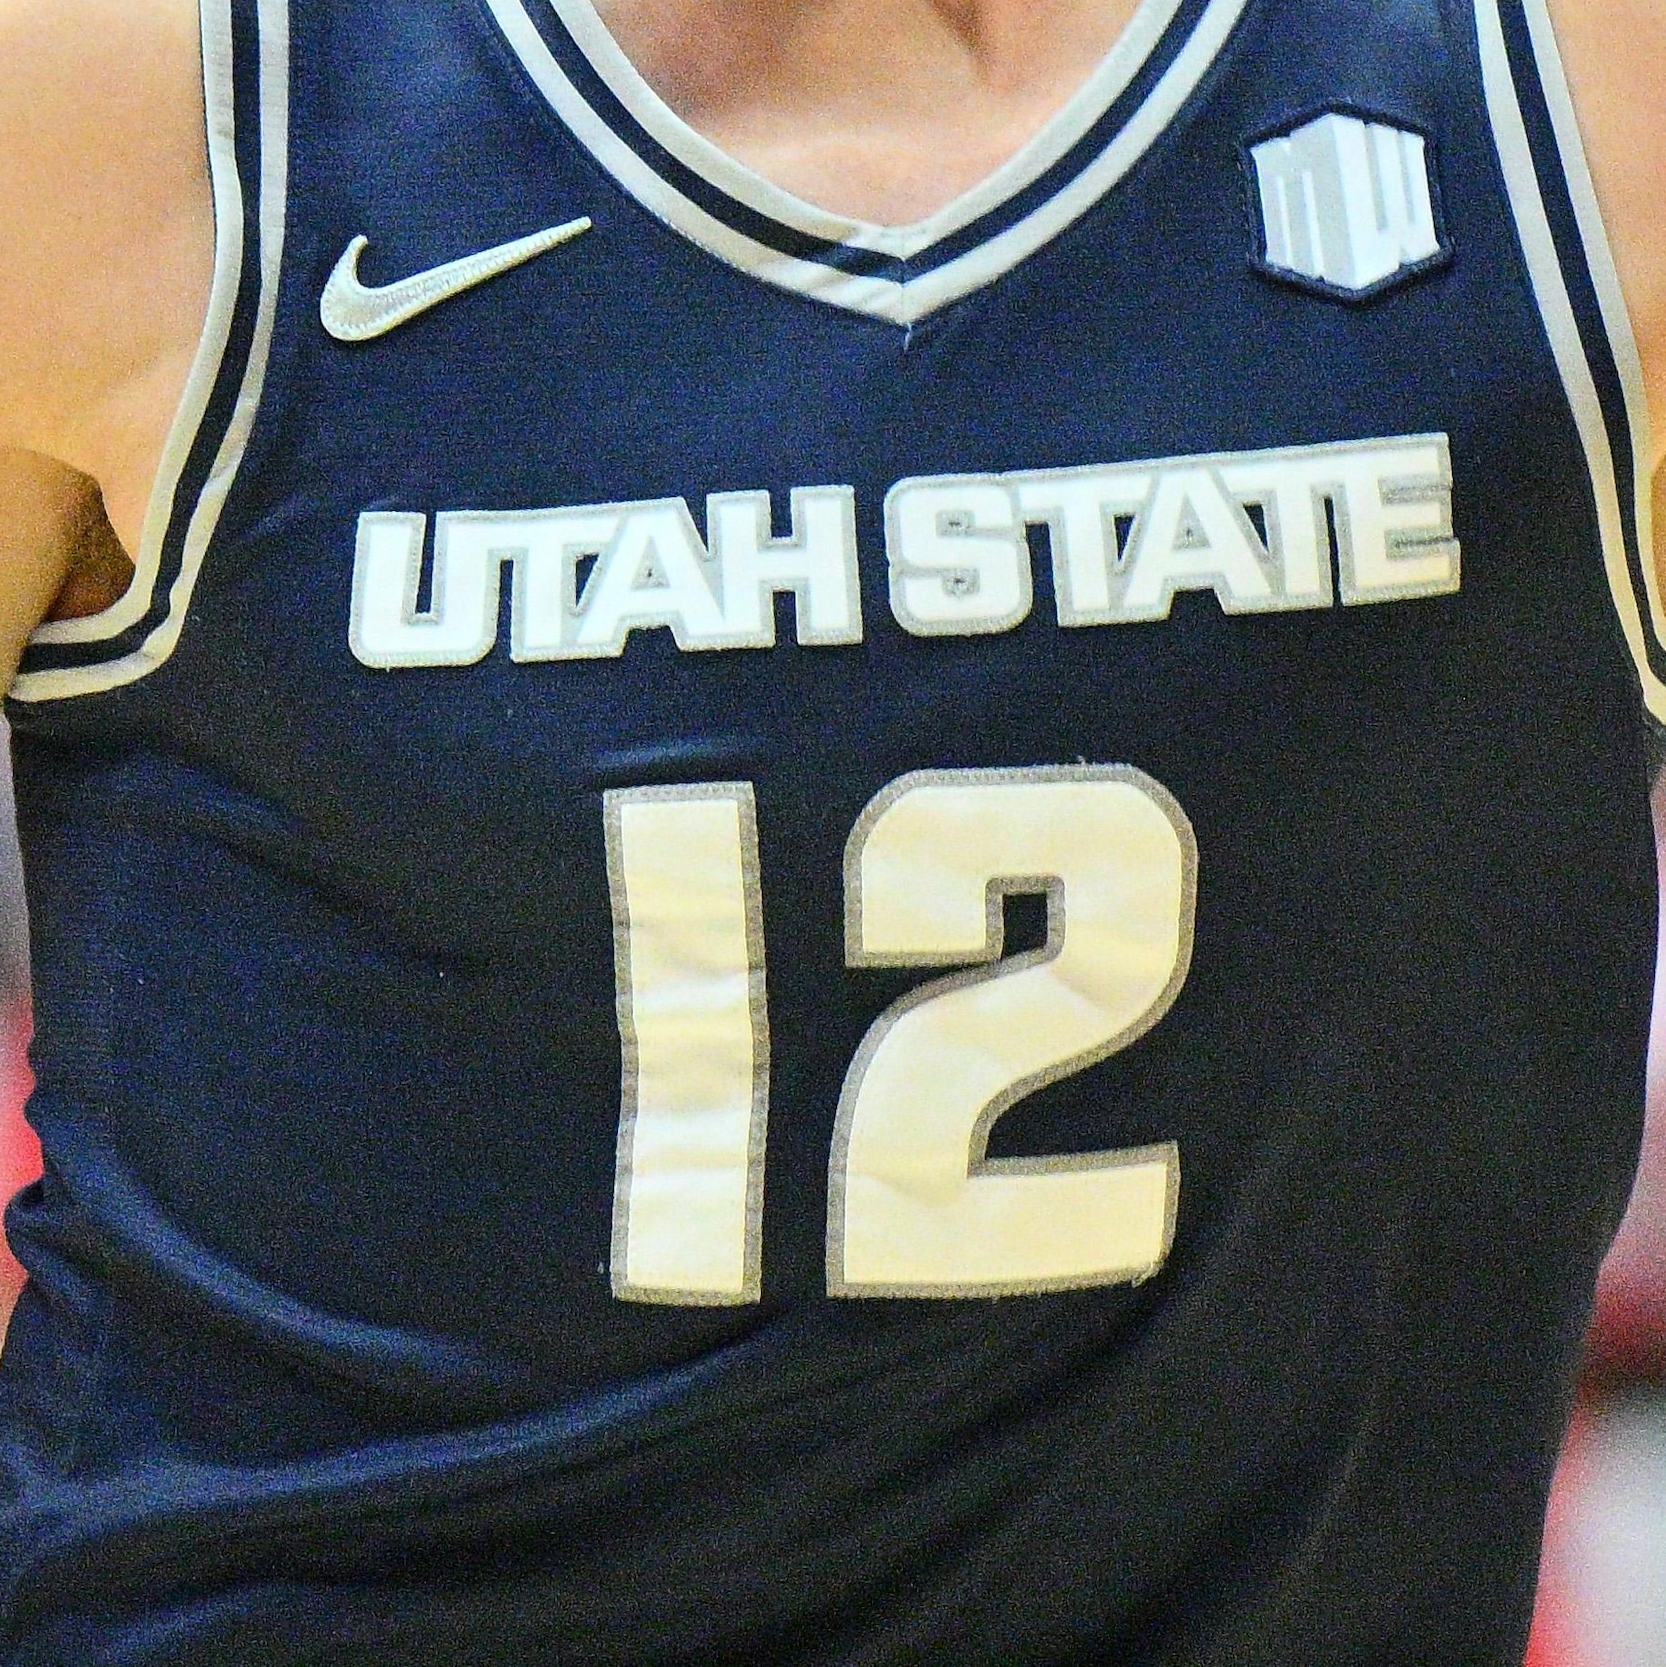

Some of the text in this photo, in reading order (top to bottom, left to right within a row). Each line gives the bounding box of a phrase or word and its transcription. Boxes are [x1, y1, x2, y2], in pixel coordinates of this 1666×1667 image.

[347, 432, 1461, 669] UTAH STATE
[603, 762, 1199, 1305] 12
